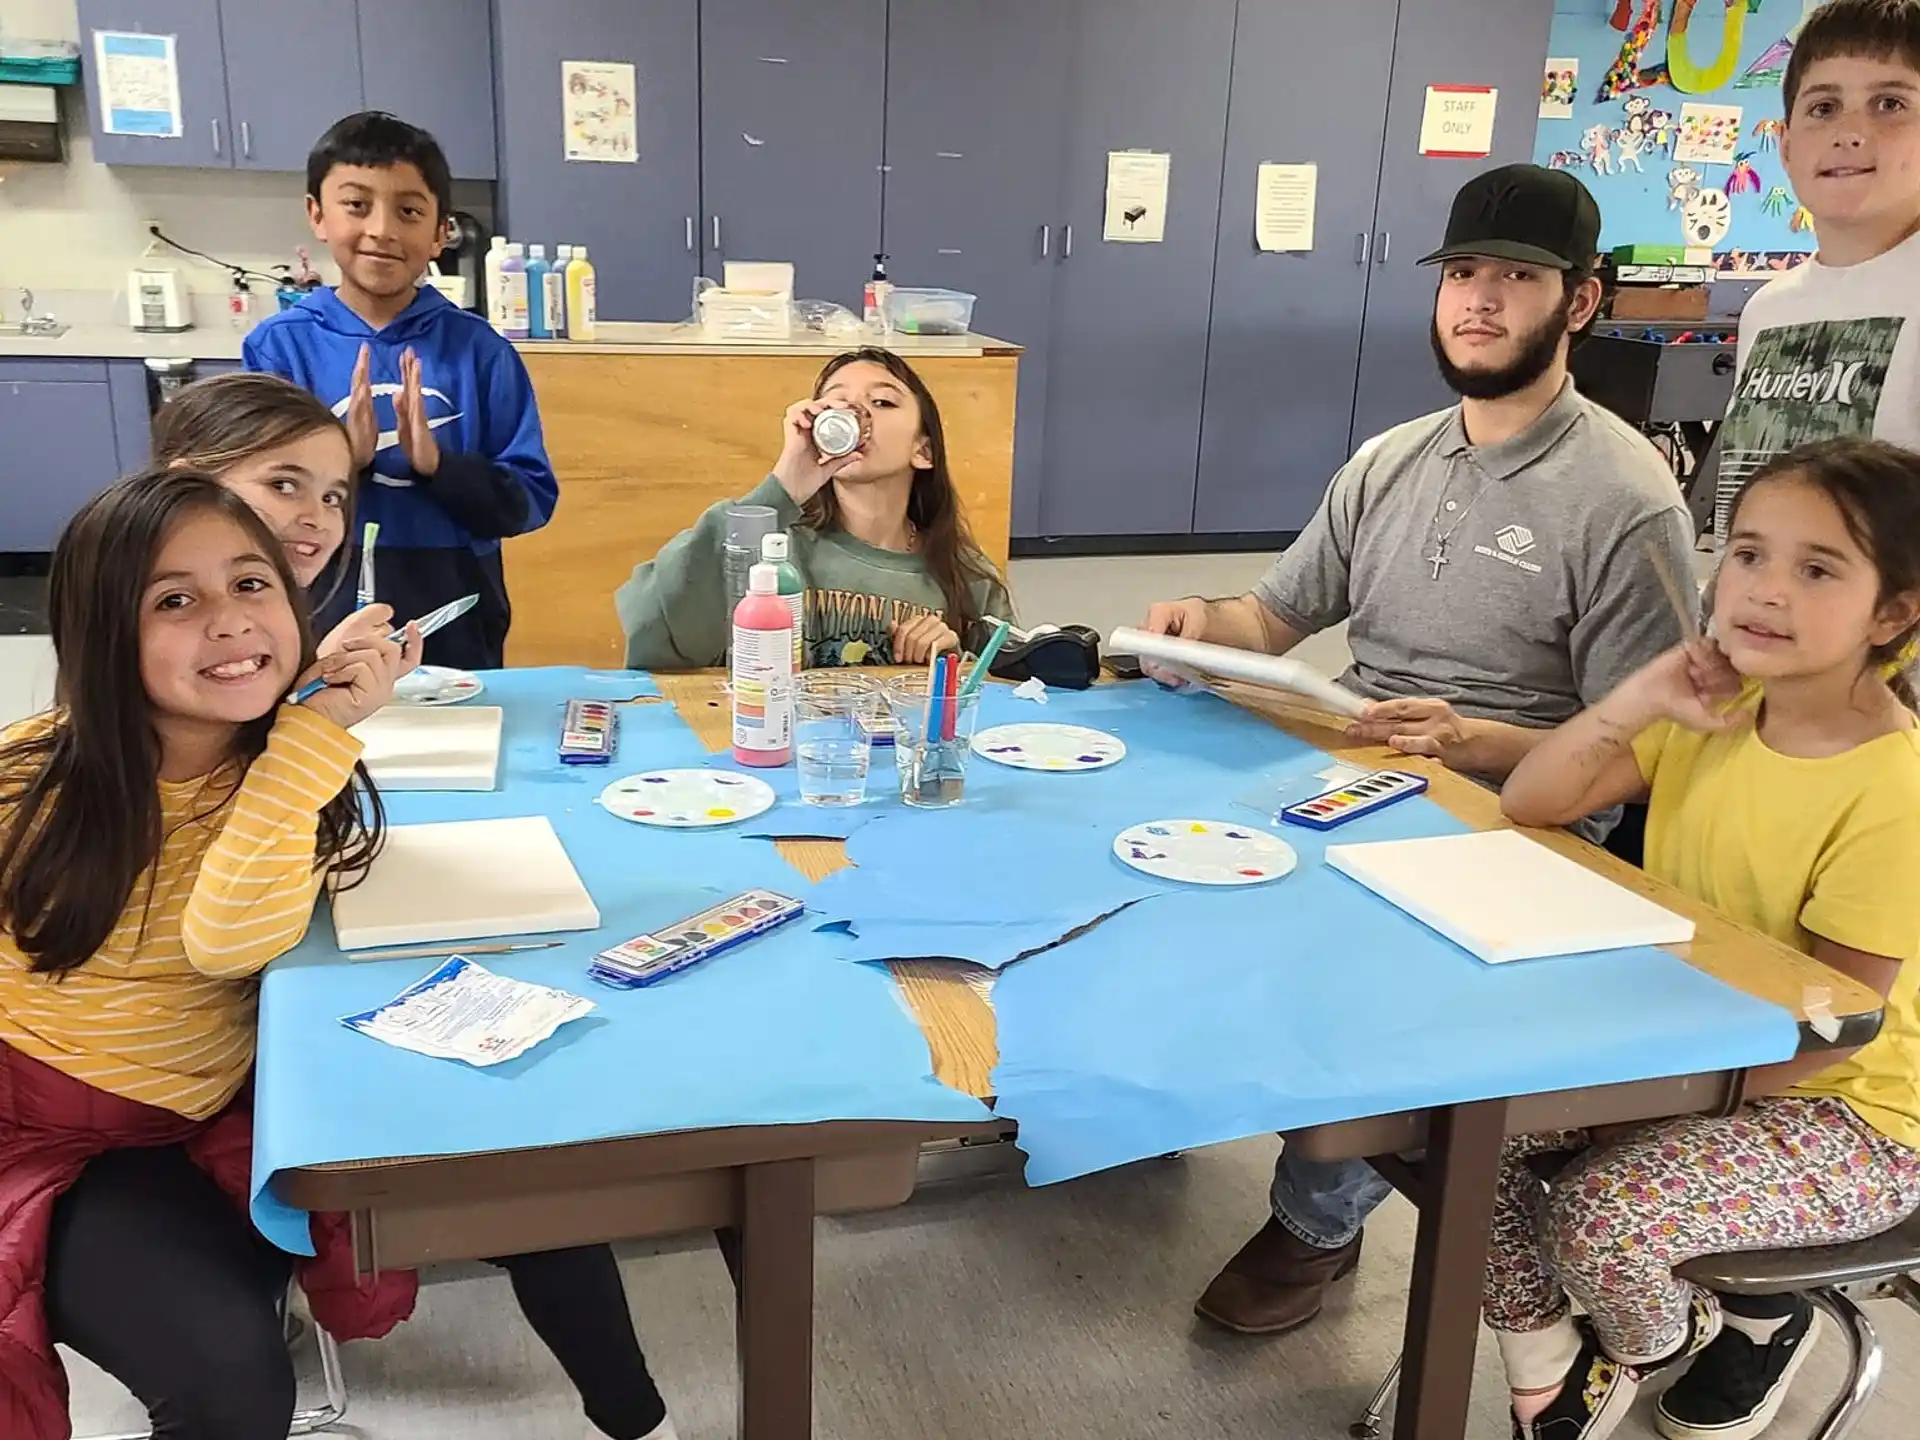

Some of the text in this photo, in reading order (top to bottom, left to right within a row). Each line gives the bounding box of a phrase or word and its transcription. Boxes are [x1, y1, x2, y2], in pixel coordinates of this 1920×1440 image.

[1443, 100, 1476, 112] STAFF
[1442, 121, 1472, 134] ONLY
[1740, 364, 1831, 402] Hurley
